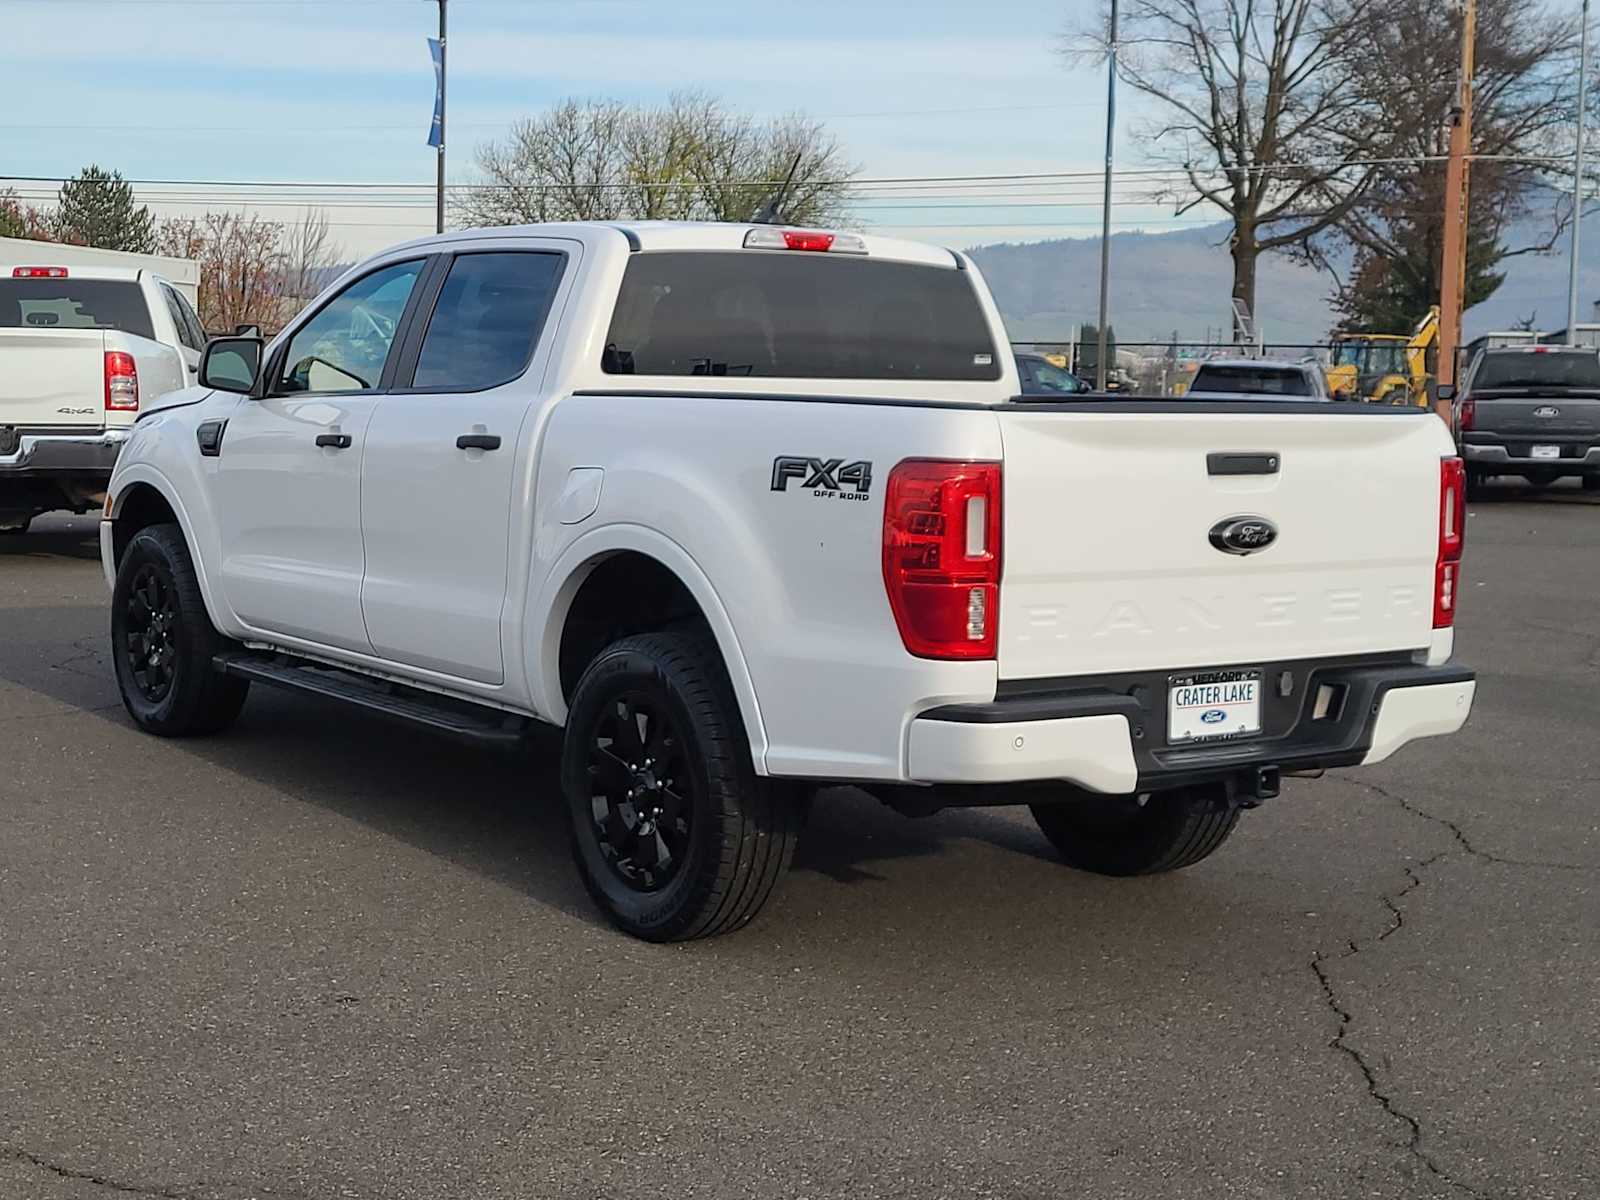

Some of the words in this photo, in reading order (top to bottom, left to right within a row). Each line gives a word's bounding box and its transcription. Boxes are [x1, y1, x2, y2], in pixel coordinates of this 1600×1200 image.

[770, 455, 873, 492] FX4
[813, 490, 836, 499] OFF
[839, 492, 870, 502] ROAD
[1239, 525, 1270, 544] Ford
[1176, 686, 1220, 706] CRATER
[1224, 683, 1253, 702] LAKE
